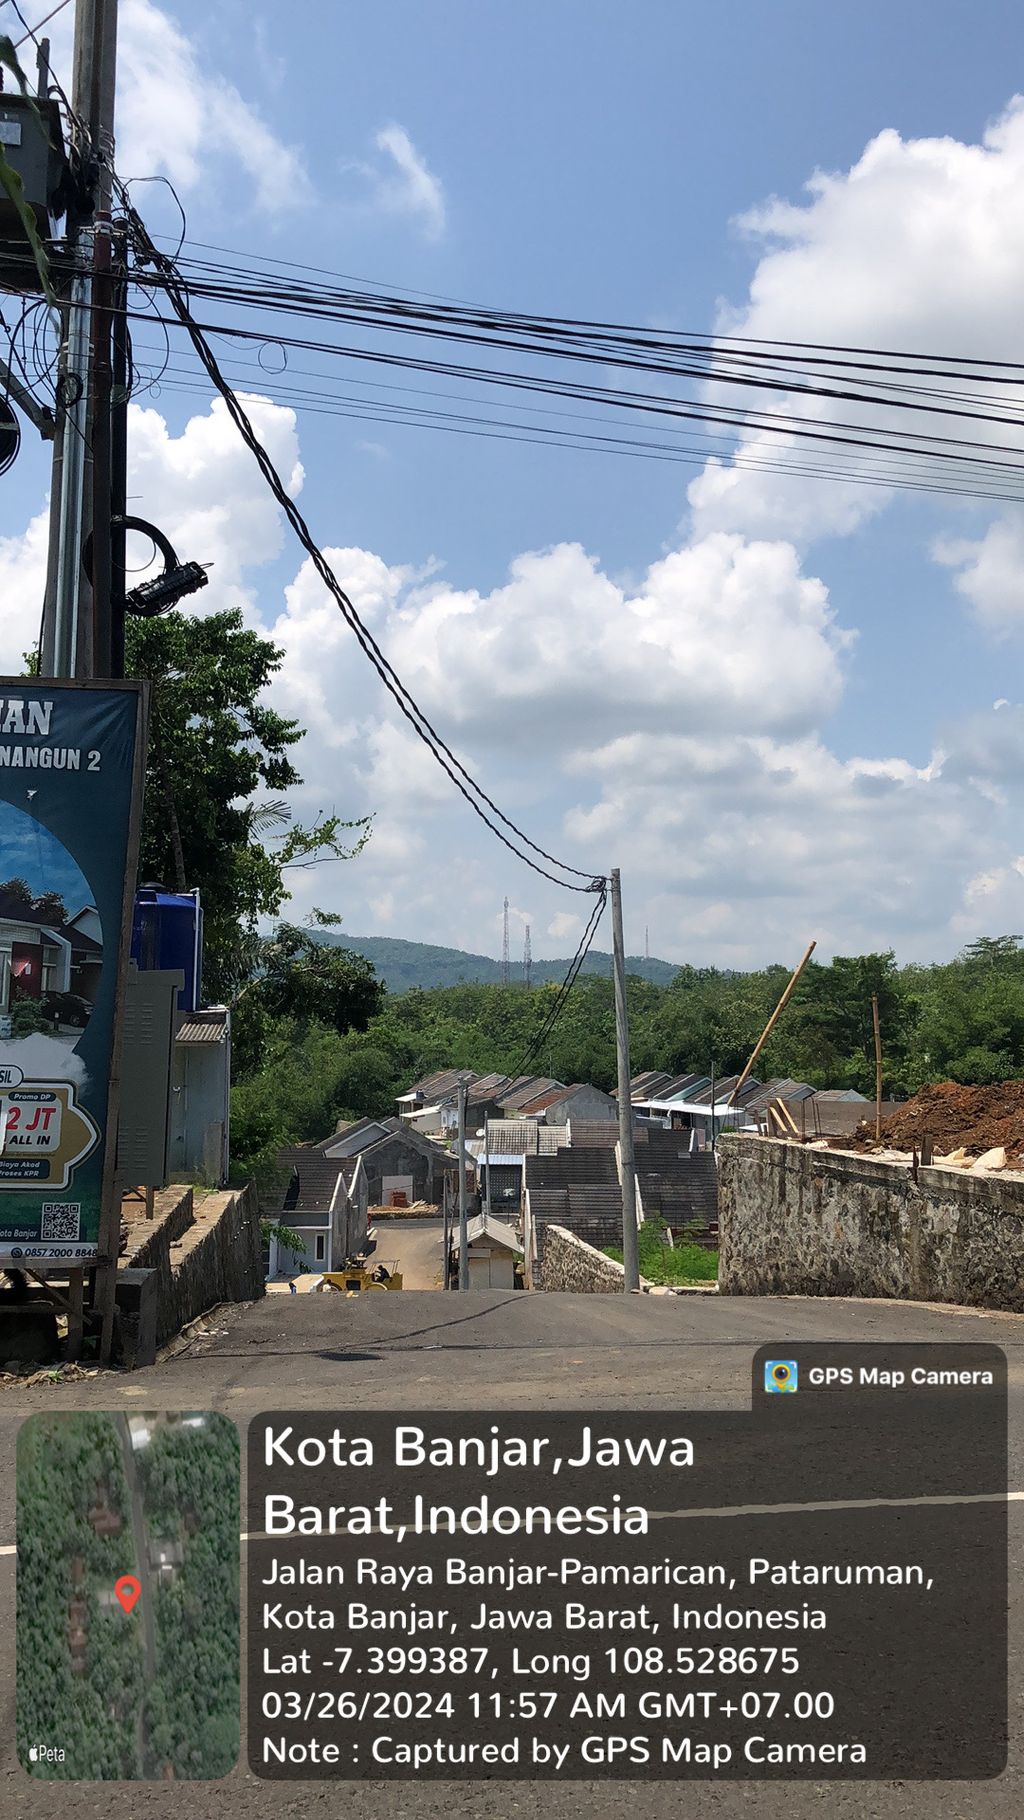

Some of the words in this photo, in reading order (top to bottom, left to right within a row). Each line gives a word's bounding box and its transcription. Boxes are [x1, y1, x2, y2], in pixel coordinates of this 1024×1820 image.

[0, 699, 53, 735] AN
[0, 746, 80, 770] NANGUN
[87, 750, 101, 771] 2
[6, 1107, 21, 1130] 2
[25, 1107, 57, 1131] JT
[9, 1135, 33, 1145] ALL
[36, 1135, 51, 1145] IN
[0, 1229, 12, 1237] ota
[13, 1229, 38, 1240] Banjar
[25, 1248, 47, 1257] 0857
[49, 1249, 73, 1257] 2000
